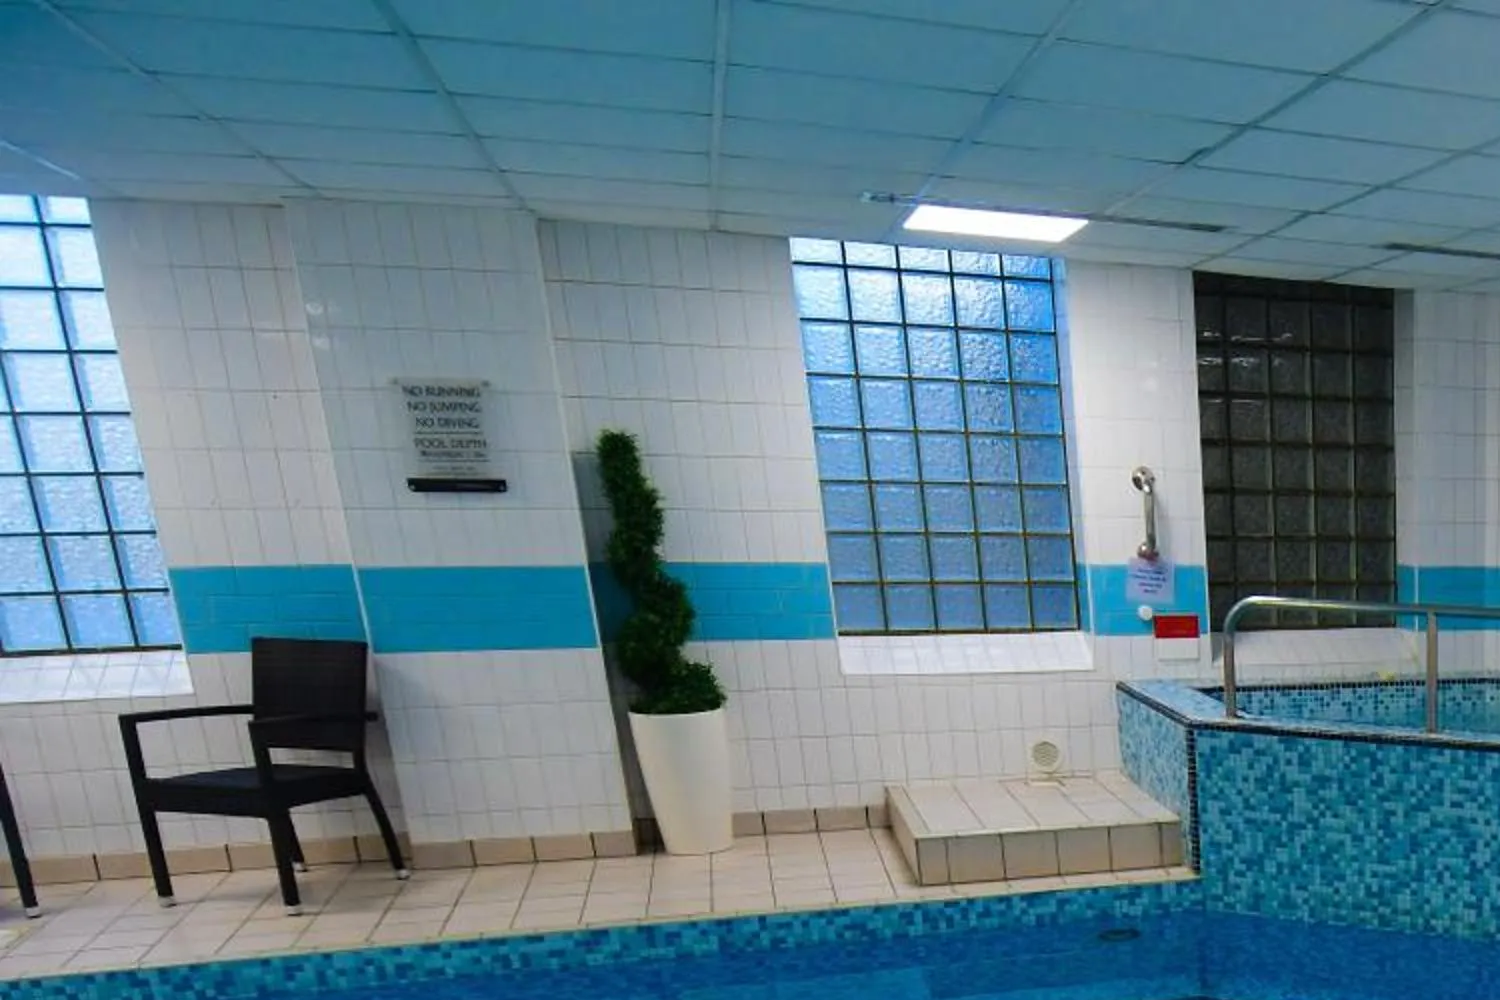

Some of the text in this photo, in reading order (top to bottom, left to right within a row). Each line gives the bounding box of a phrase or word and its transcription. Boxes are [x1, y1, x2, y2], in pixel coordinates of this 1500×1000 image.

[402, 385, 423, 397] NO
[407, 401, 427, 412] NO
[415, 417, 435, 428] NO
[413, 437, 448, 449] POOL
